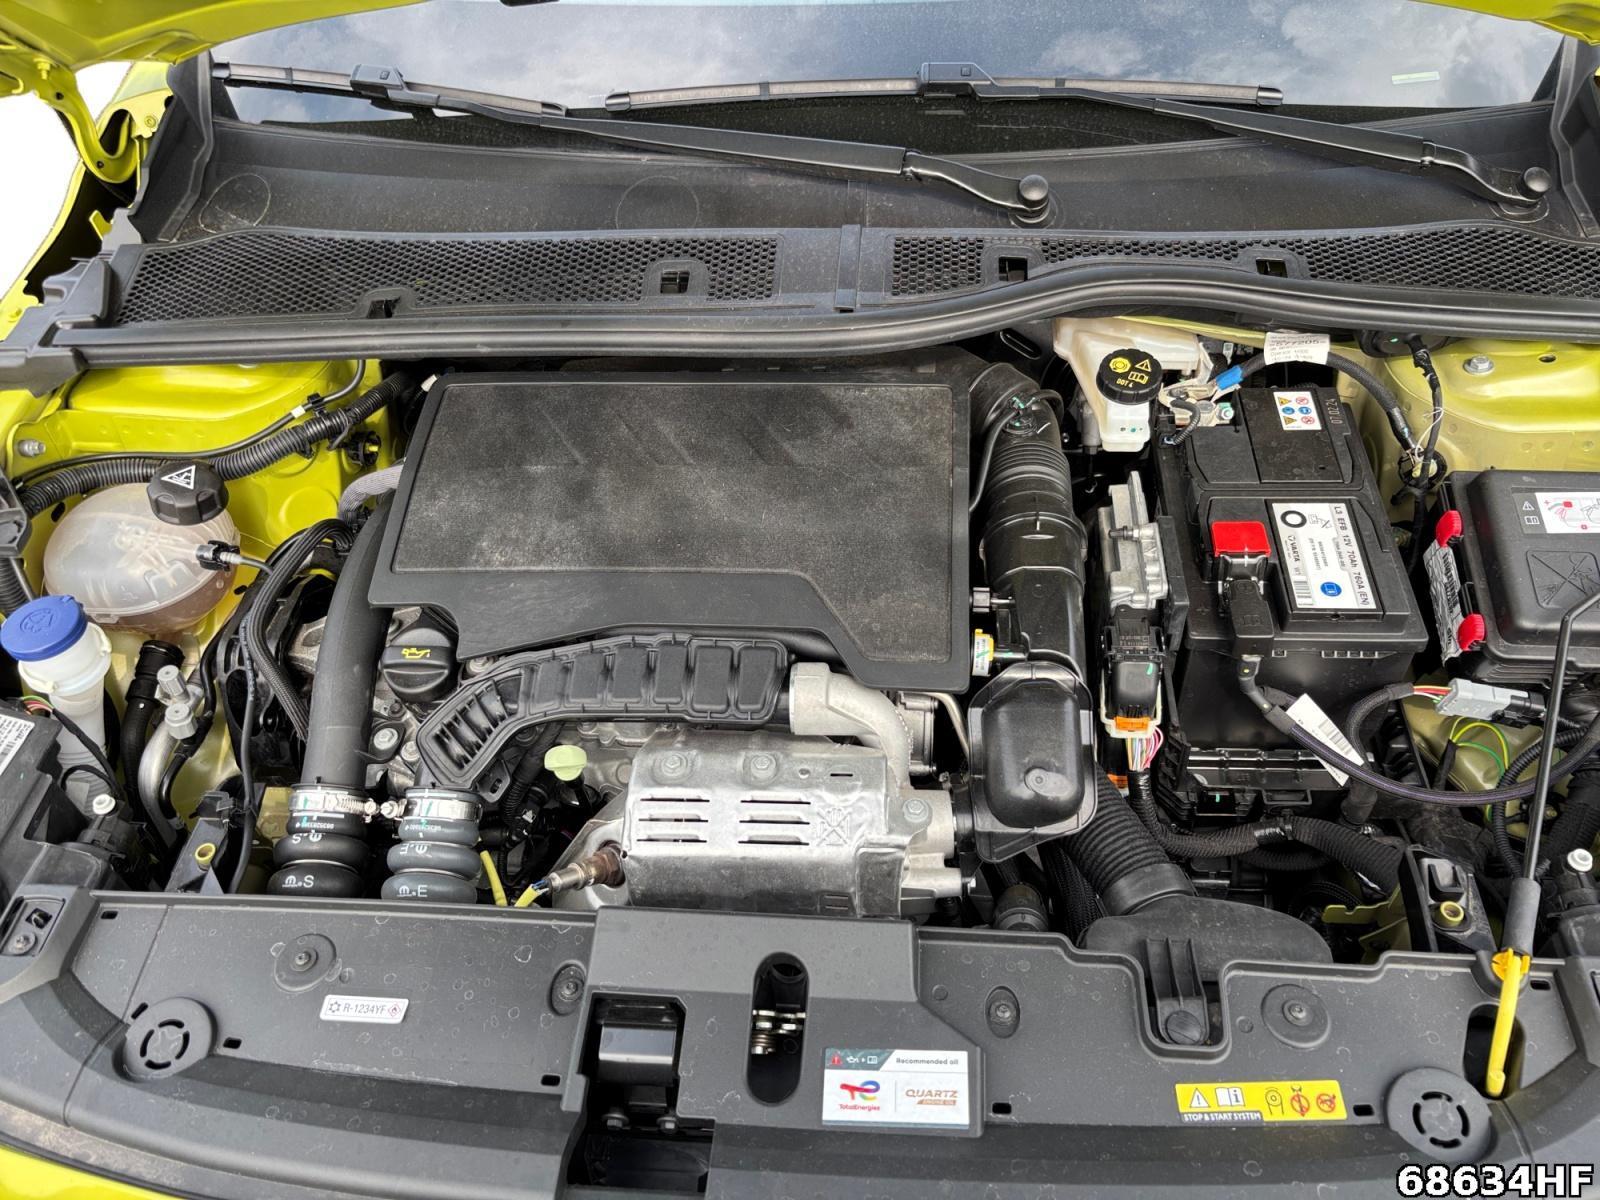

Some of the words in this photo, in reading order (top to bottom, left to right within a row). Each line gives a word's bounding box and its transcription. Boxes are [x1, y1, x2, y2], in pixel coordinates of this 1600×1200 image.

[1337, 517, 1348, 531] EFB
[1342, 534, 1352, 547] 12V
[1290, 541, 1301, 562] VARTA
[1347, 551, 1358, 568] 70Ah
[1353, 572, 1365, 590] 760A
[342, 1002, 386, 1015] R-1234YF
[895, 1057, 948, 1065] Recommended
[905, 1089, 958, 1098] QUARTZ
[839, 1103, 881, 1112] TotalEnergies
[1183, 1113, 1202, 1121] STOP
[1209, 1112, 1232, 1121] START
[1233, 1112, 1261, 1121] SYSTEM
